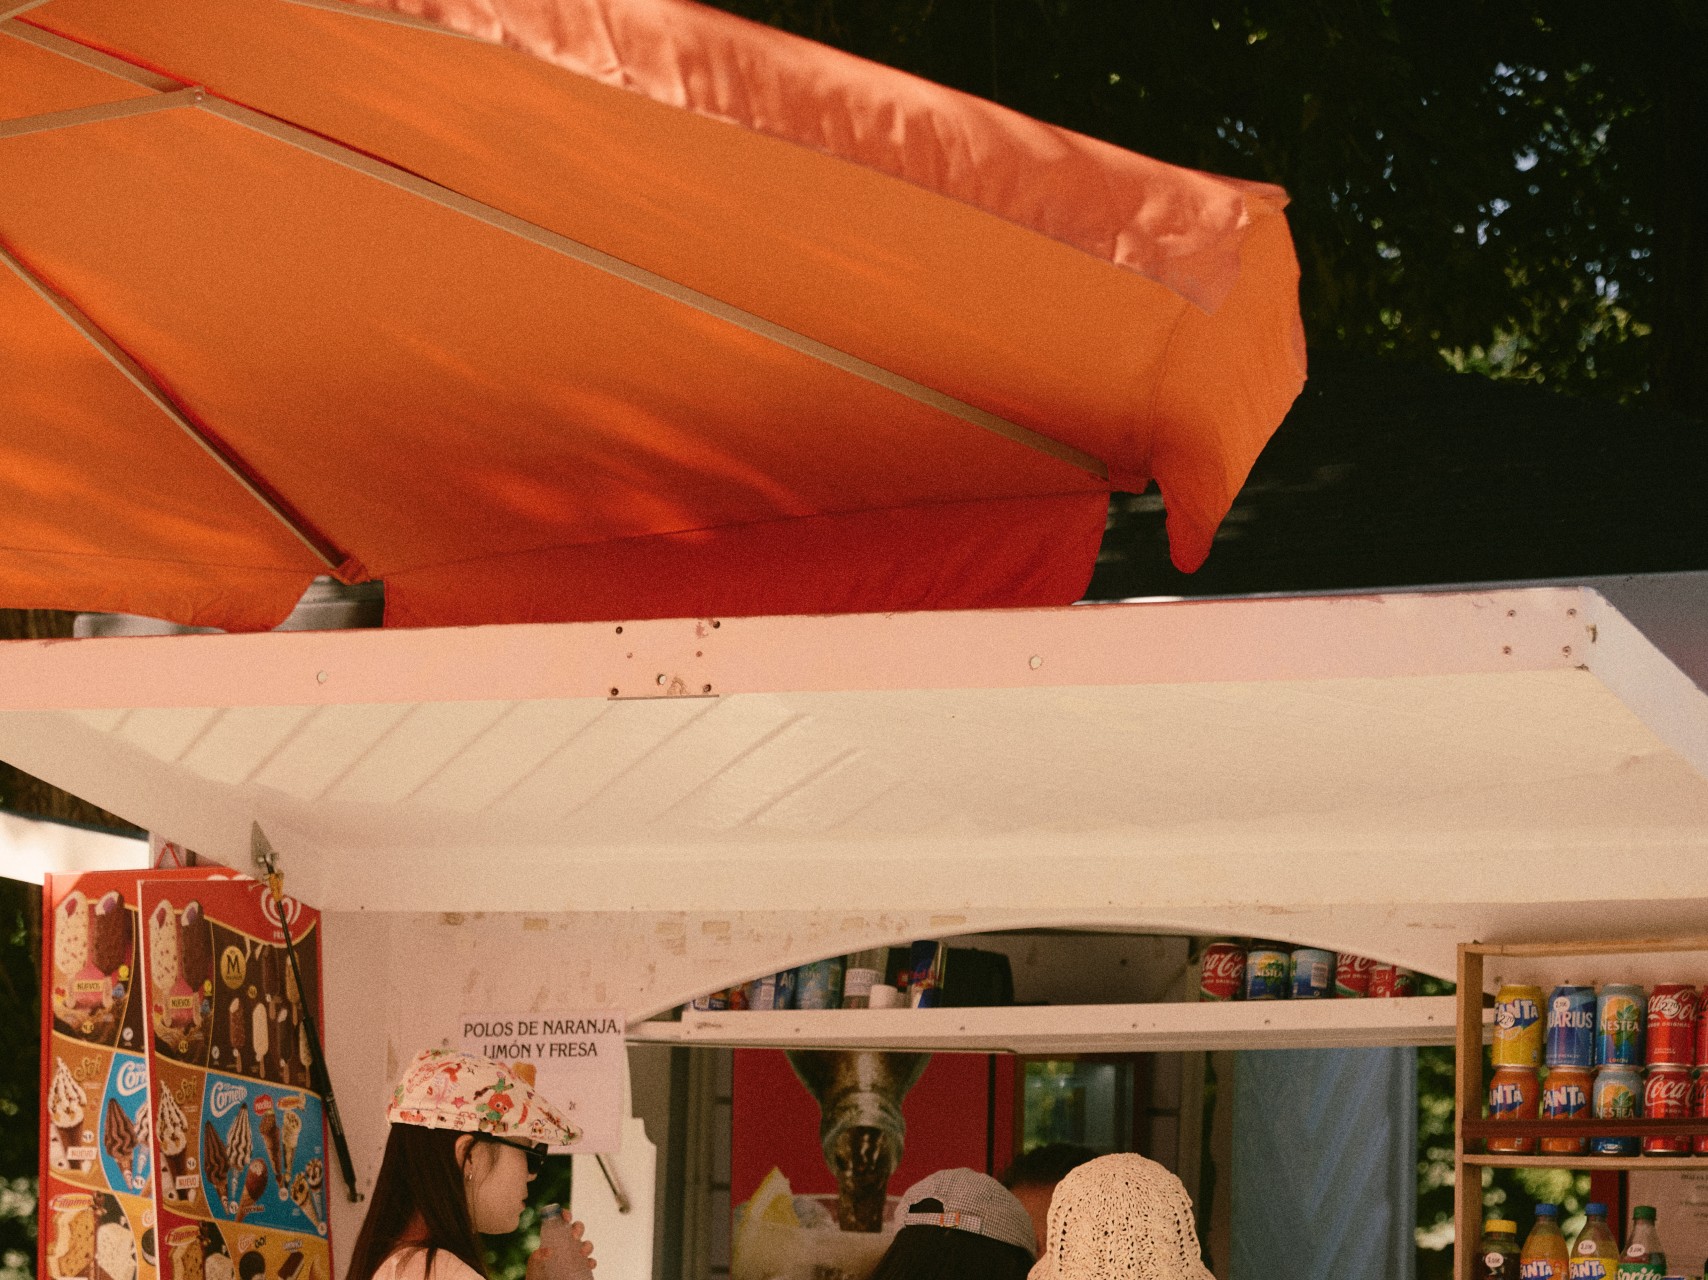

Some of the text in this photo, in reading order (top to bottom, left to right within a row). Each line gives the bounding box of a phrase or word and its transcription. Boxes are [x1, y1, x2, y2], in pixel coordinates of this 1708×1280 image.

[463, 1018, 621, 1038] POLOS DE NARANJA,
[1601, 1020, 1640, 1032] NESTEA
[484, 1039, 597, 1059] LIMÓN Y FRESA
[210, 1081, 248, 1118] Cornetto
